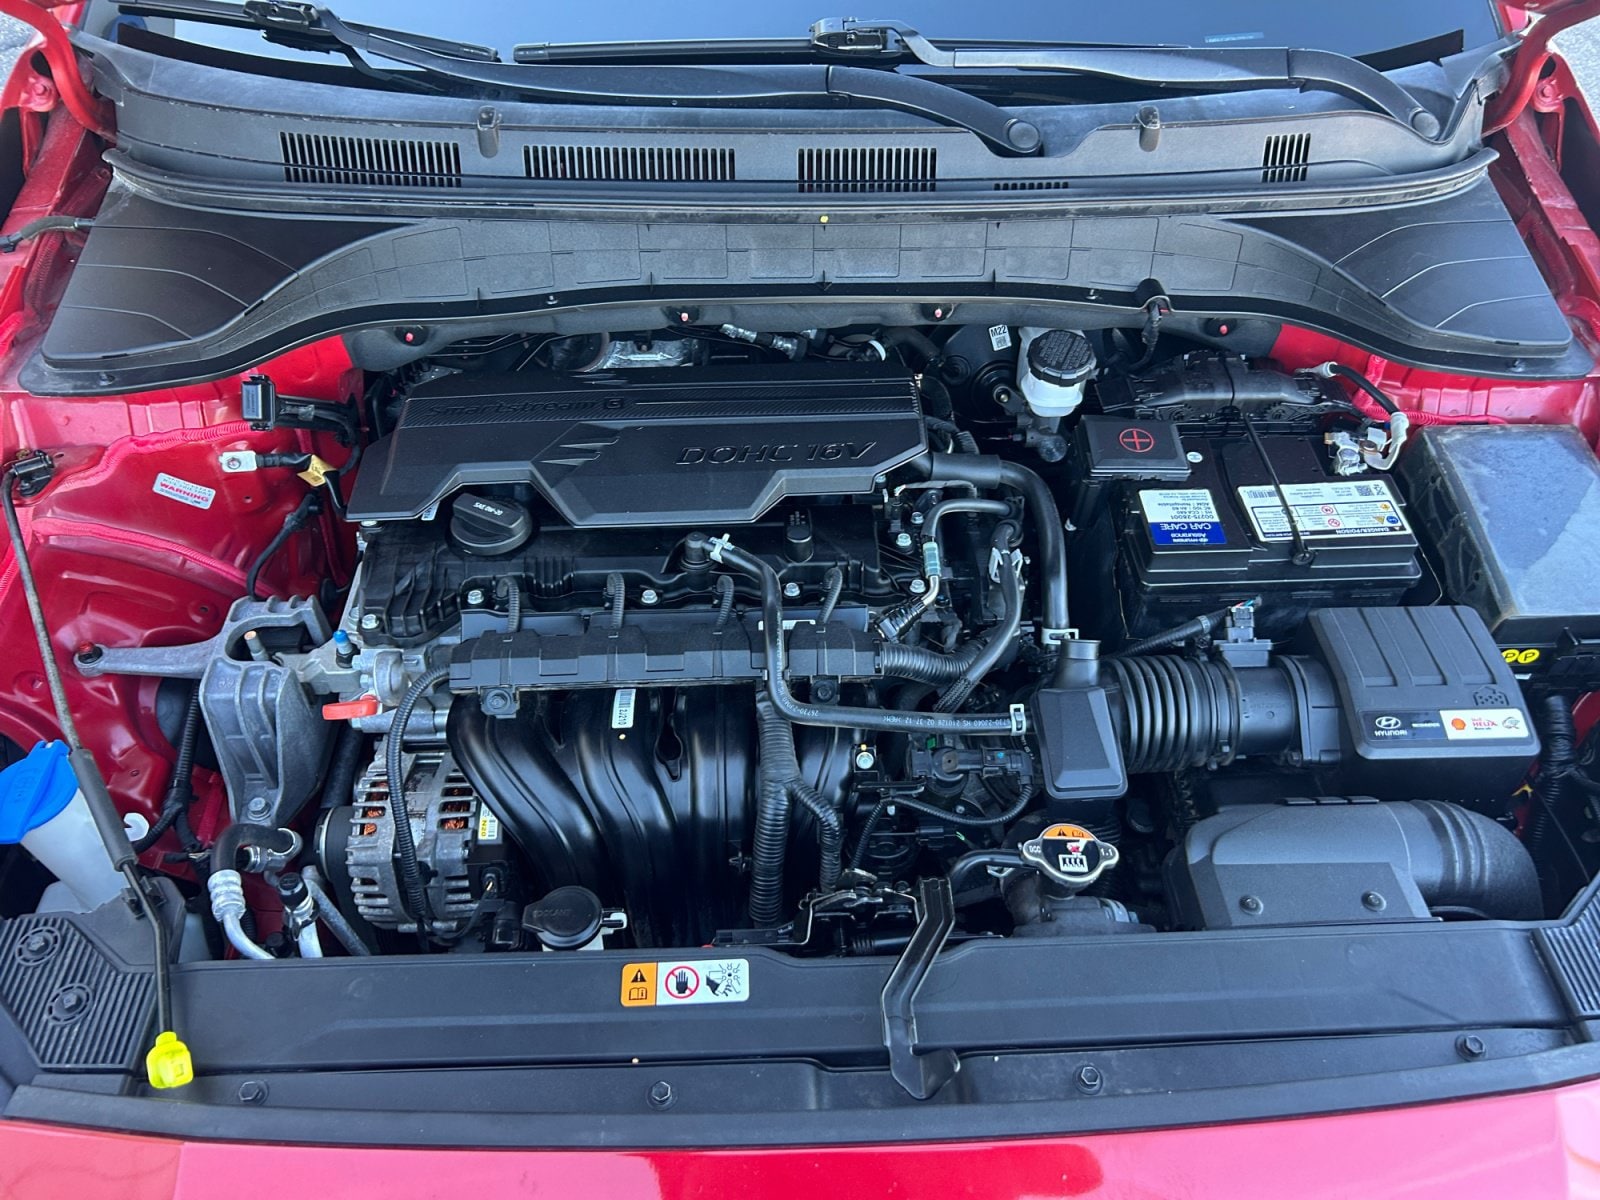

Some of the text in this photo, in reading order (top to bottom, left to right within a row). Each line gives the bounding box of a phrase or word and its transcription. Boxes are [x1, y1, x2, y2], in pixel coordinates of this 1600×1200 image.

[990, 325, 1007, 337] M22
[674, 441, 877, 465] DOHC 16V
[160, 481, 209, 502] WARNING
[1159, 522, 1212, 531] CAR CARE
[1374, 729, 1408, 737] HYUNDAI
[1100, 848, 1114, 857] 1.1
